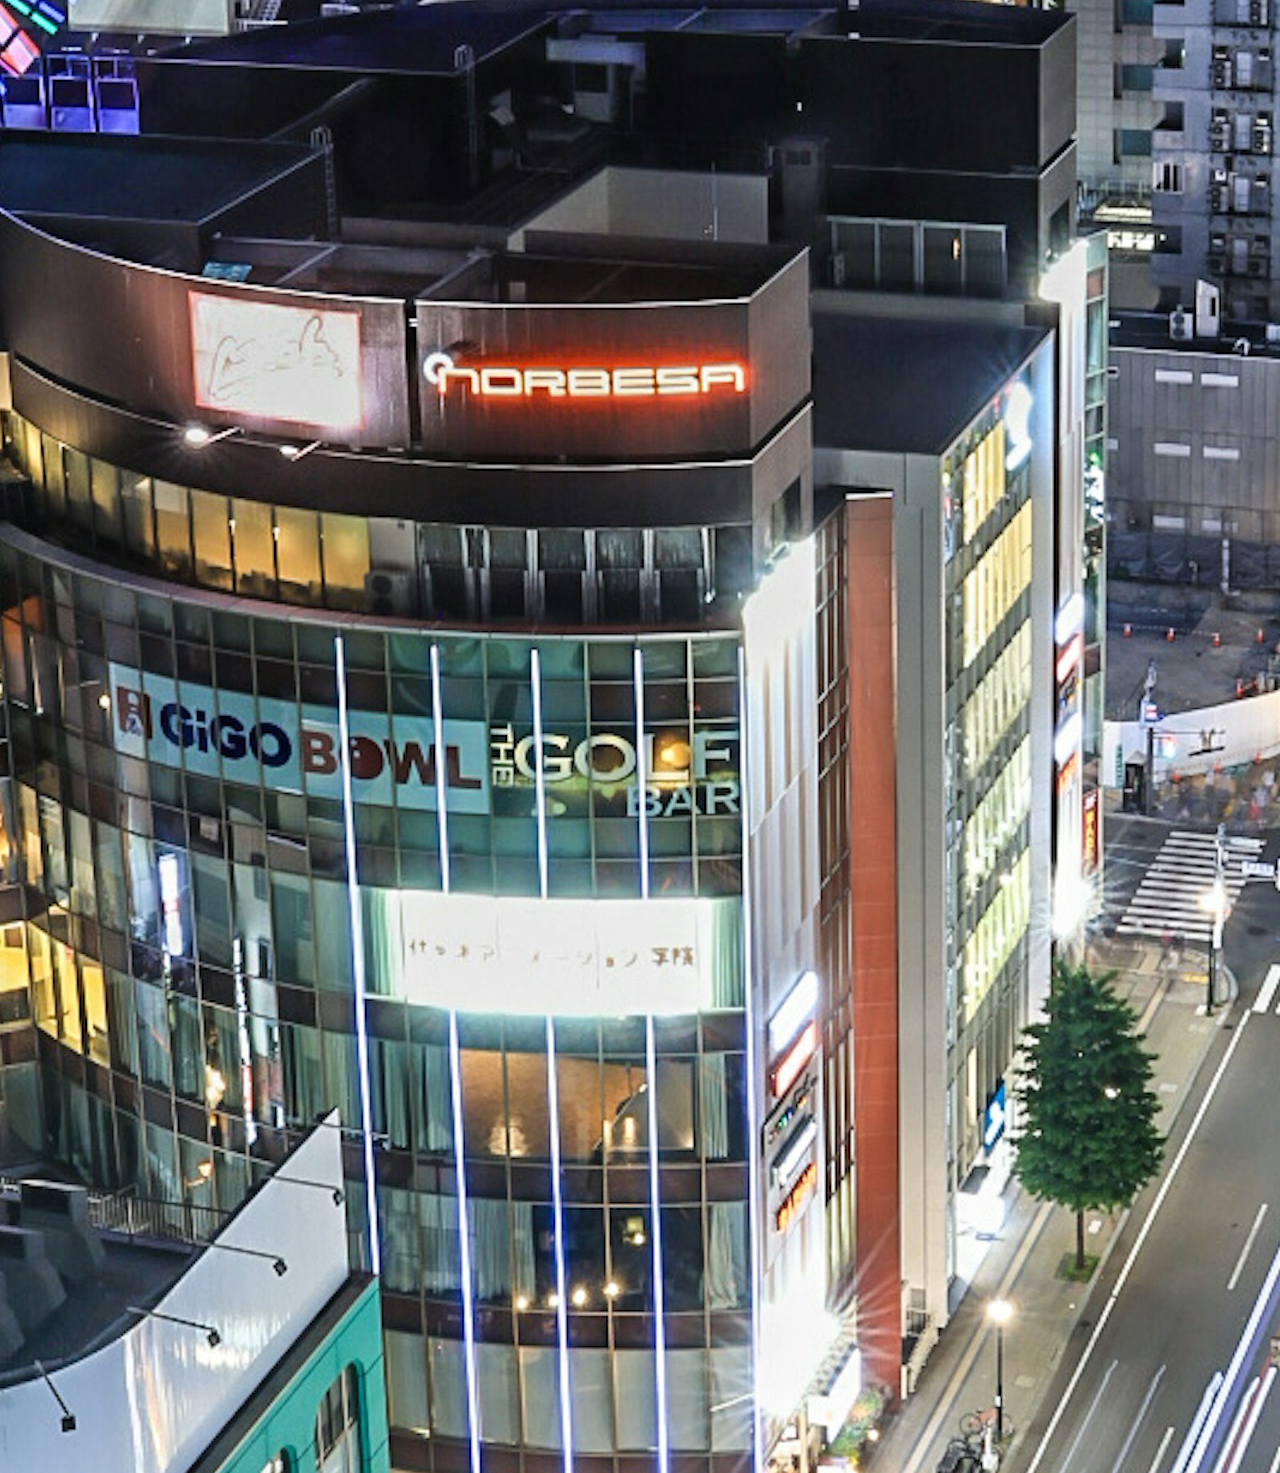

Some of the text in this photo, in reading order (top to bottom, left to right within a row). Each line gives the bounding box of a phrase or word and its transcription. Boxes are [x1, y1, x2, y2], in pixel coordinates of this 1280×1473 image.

[301, 729, 482, 790] BOWL
[489, 722, 739, 787] THE GOLF
[626, 782, 740, 817] BAR
